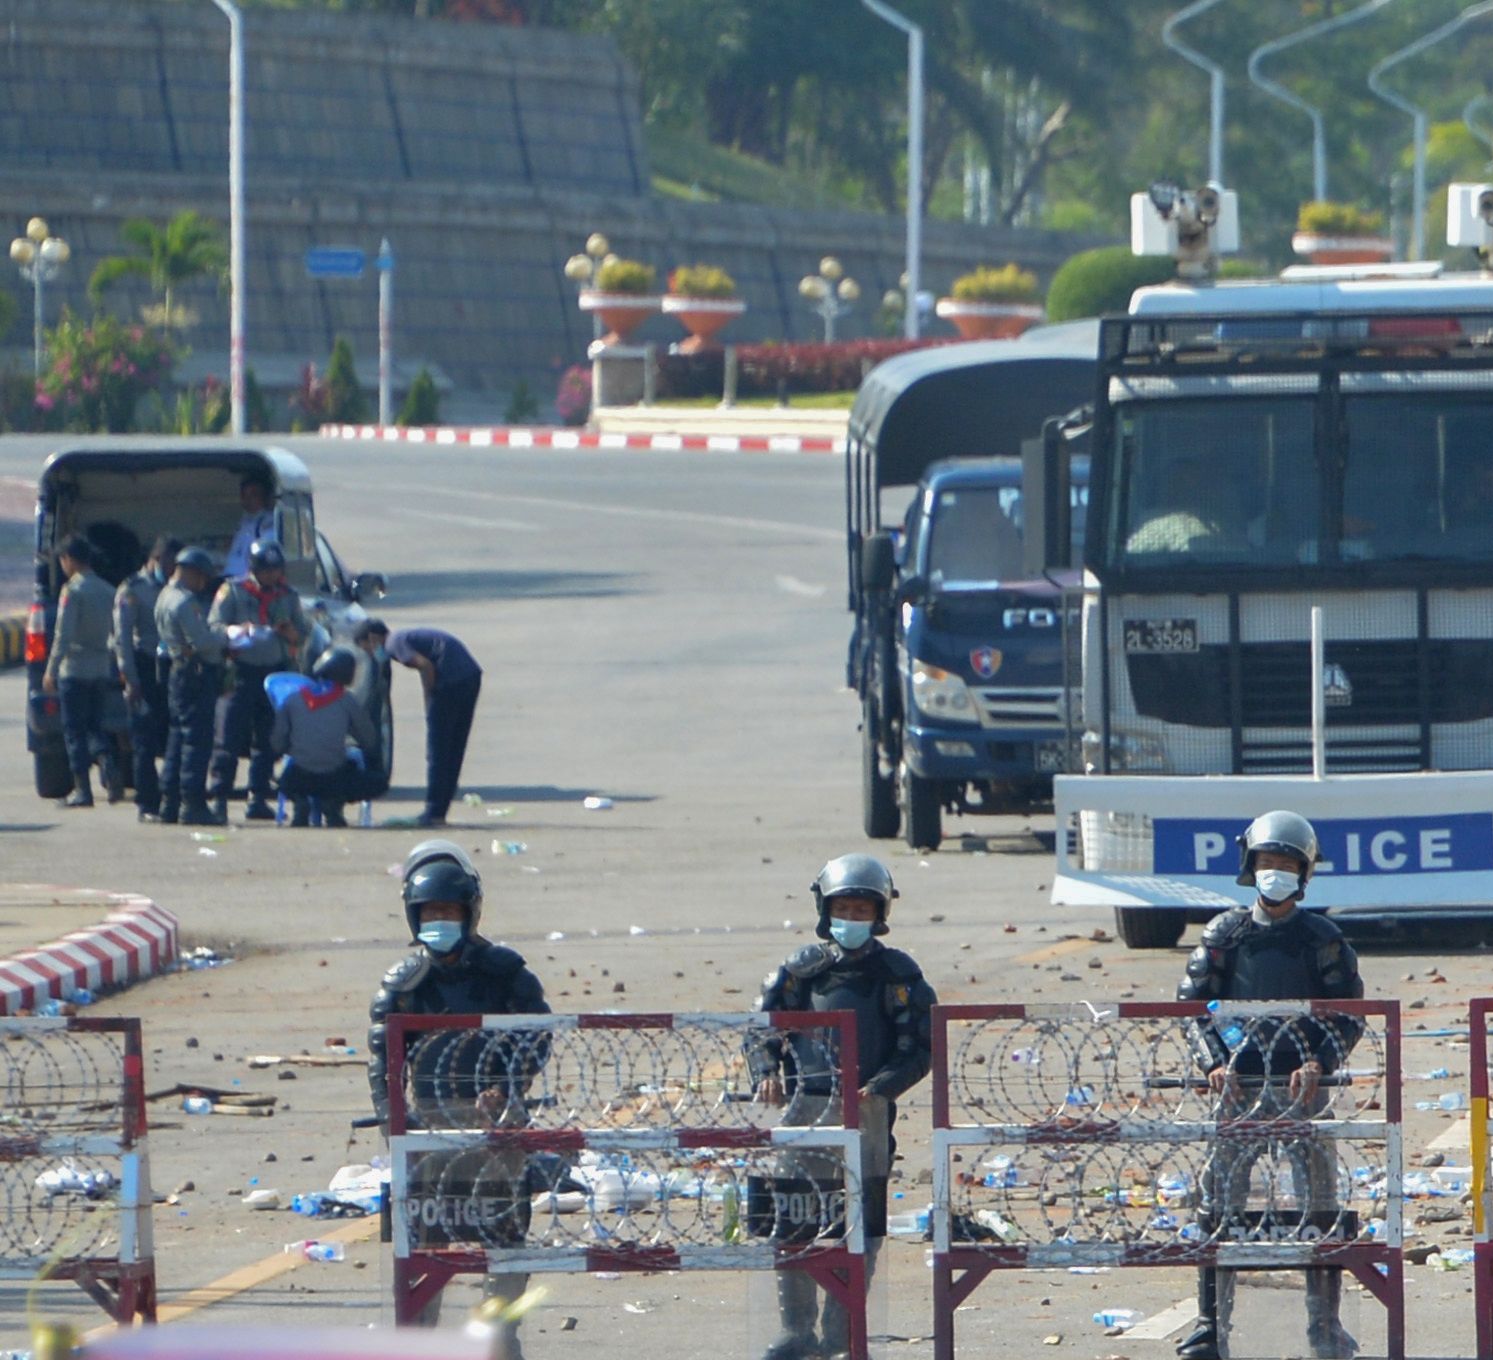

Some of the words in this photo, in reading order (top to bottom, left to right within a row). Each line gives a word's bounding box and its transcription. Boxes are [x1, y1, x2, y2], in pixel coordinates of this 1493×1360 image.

[1193, 829, 1454, 872] PICE
[406, 1198, 497, 1227] POLICE
[775, 1192, 845, 1225] POLIC
